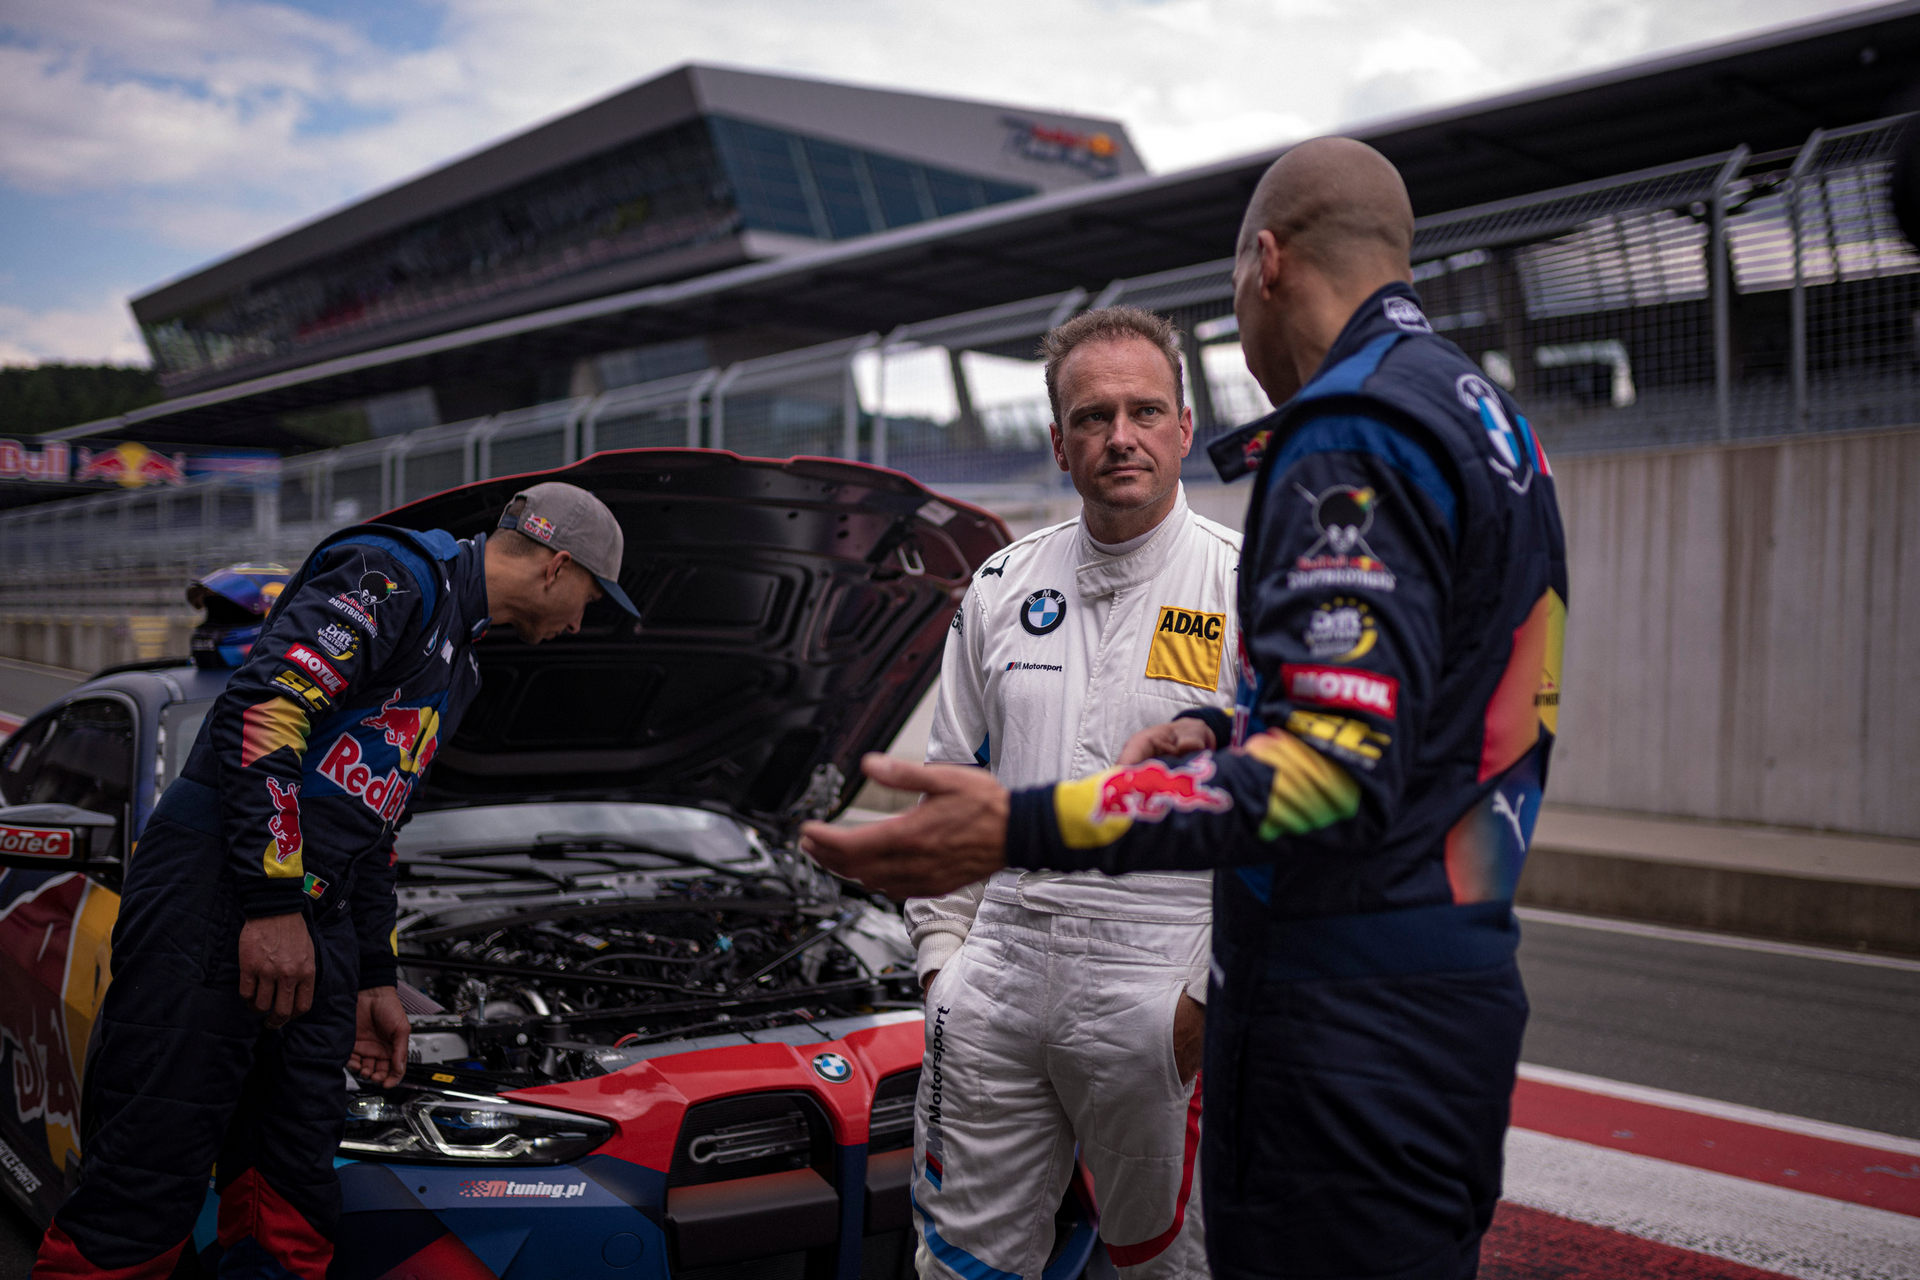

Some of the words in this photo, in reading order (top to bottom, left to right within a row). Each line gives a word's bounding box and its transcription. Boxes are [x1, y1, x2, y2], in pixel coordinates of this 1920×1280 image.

[325, 623, 352, 647] Drift
[328, 597, 378, 639] DRIFTBROTHERS
[1160, 610, 1221, 640] ADAC
[317, 627, 349, 651] MASTERS
[291, 648, 342, 692] MOTUL
[1022, 662, 1062, 672] Motorsport
[1293, 671, 1391, 710] MOTUL
[317, 732, 398, 814] Red
[928, 1005, 950, 1124] Motorsport
